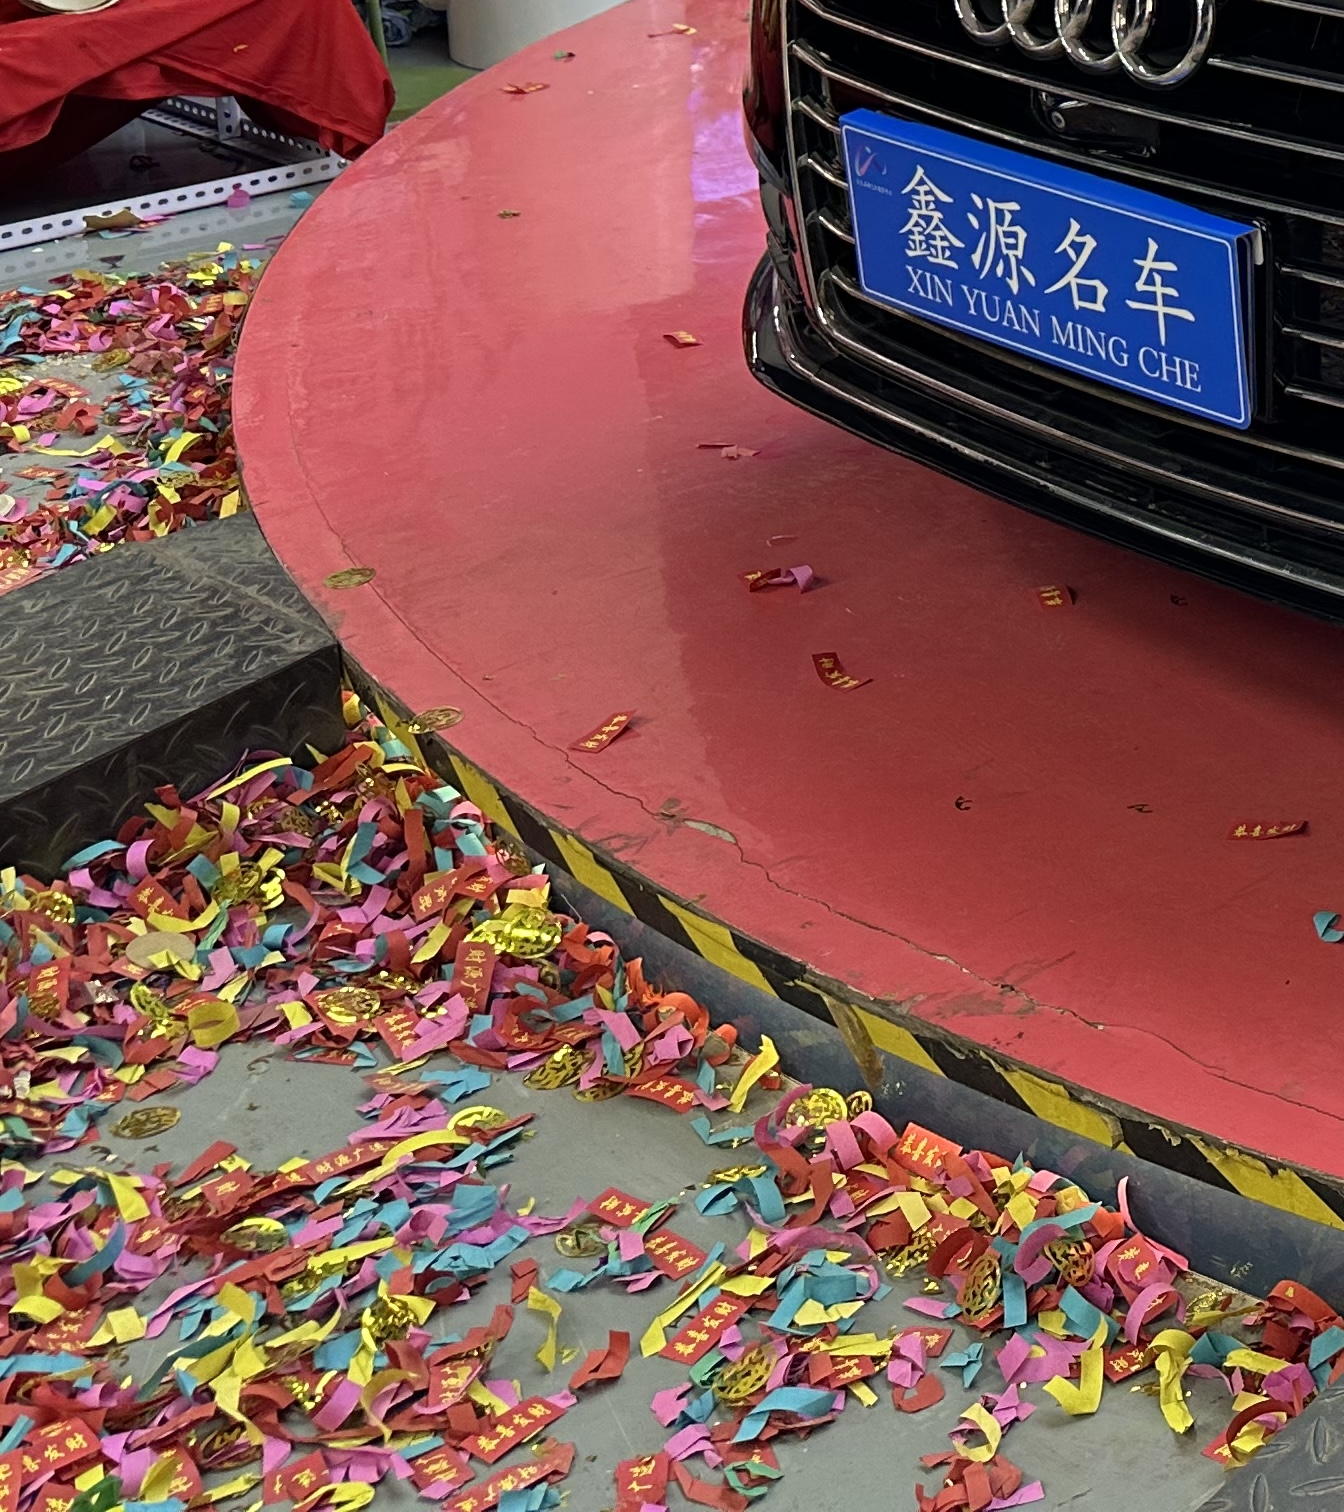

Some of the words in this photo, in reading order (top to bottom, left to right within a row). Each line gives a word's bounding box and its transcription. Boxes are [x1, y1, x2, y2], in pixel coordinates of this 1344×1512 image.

[899, 164, 1196, 346] 鑫源名车
[905, 264, 953, 307] XIN
[961, 284, 1041, 338] YUAN
[1050, 316, 1129, 368] MING
[1138, 346, 1202, 393] CHE
